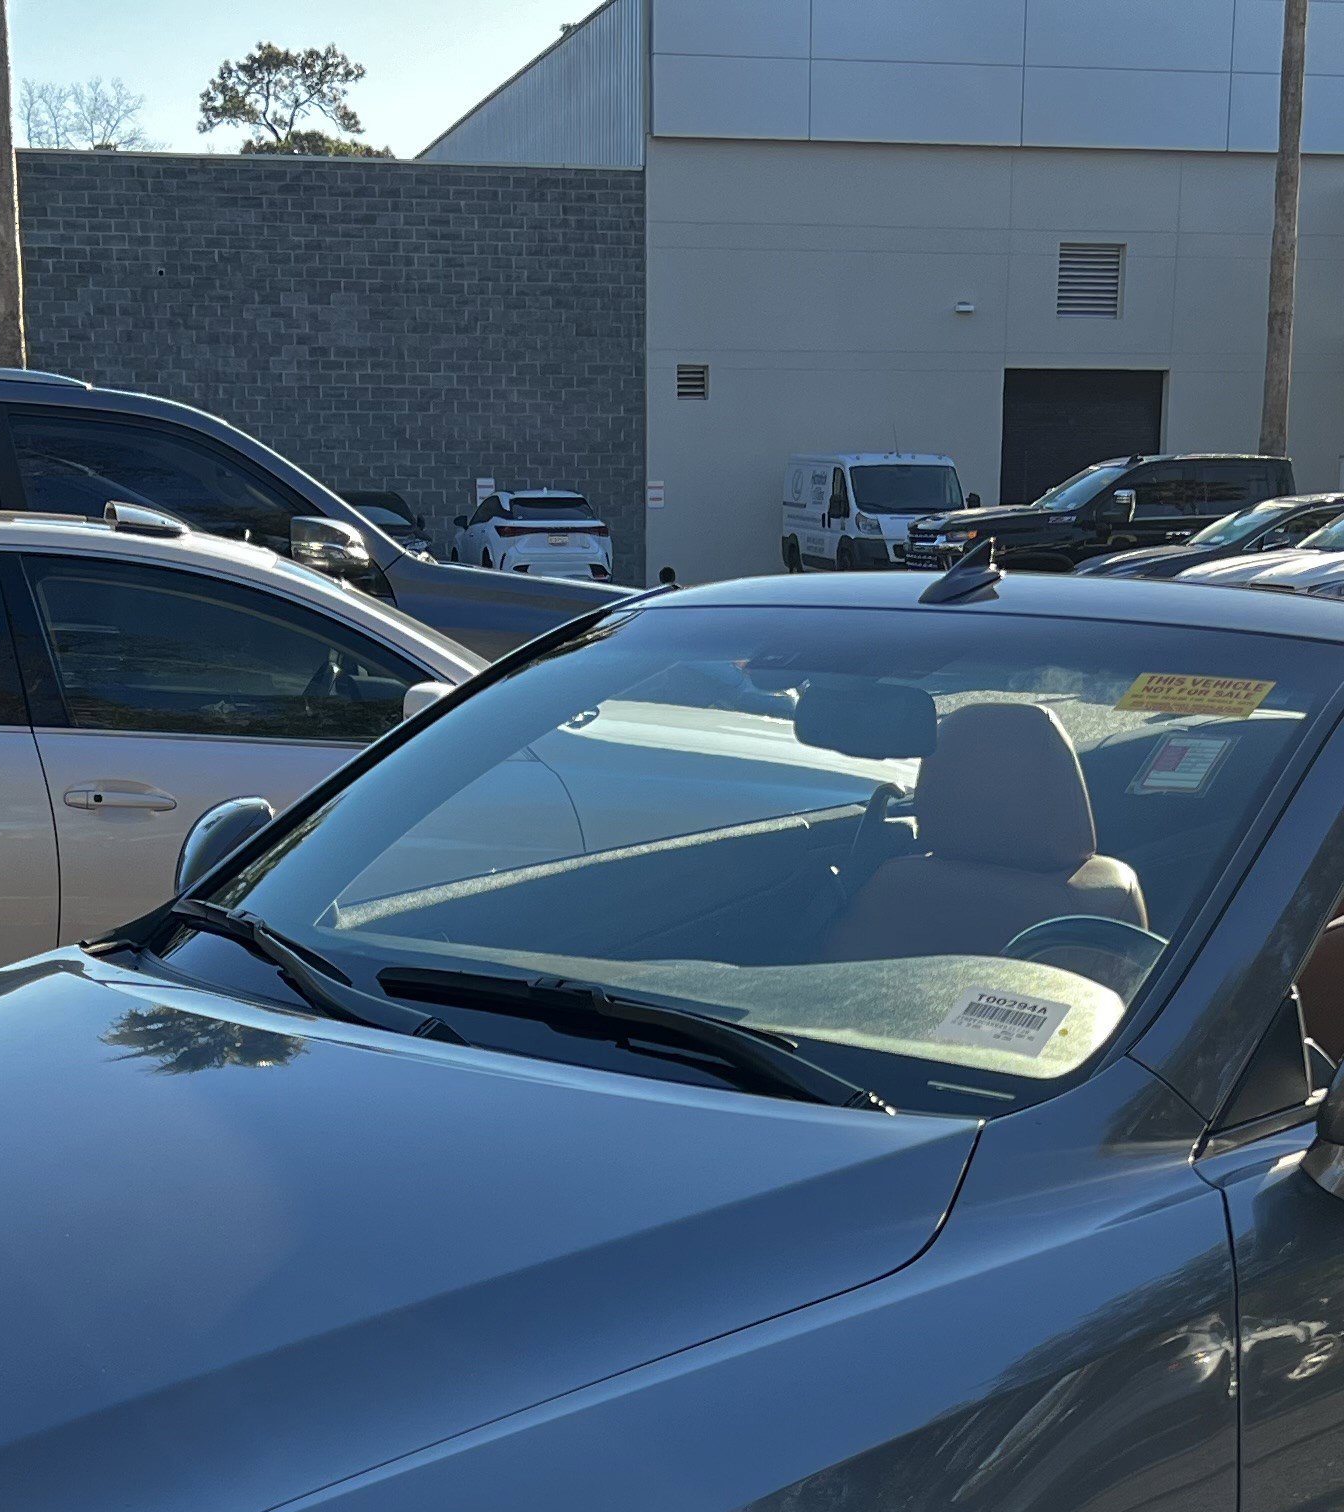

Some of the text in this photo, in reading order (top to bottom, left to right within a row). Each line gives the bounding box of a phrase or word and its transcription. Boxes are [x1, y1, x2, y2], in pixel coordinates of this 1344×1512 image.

[1147, 675, 1267, 692] THIS VEHICLE
[1141, 685, 1173, 695] NOT
[1176, 687, 1209, 696] FOR
[1213, 690, 1256, 699] SALE
